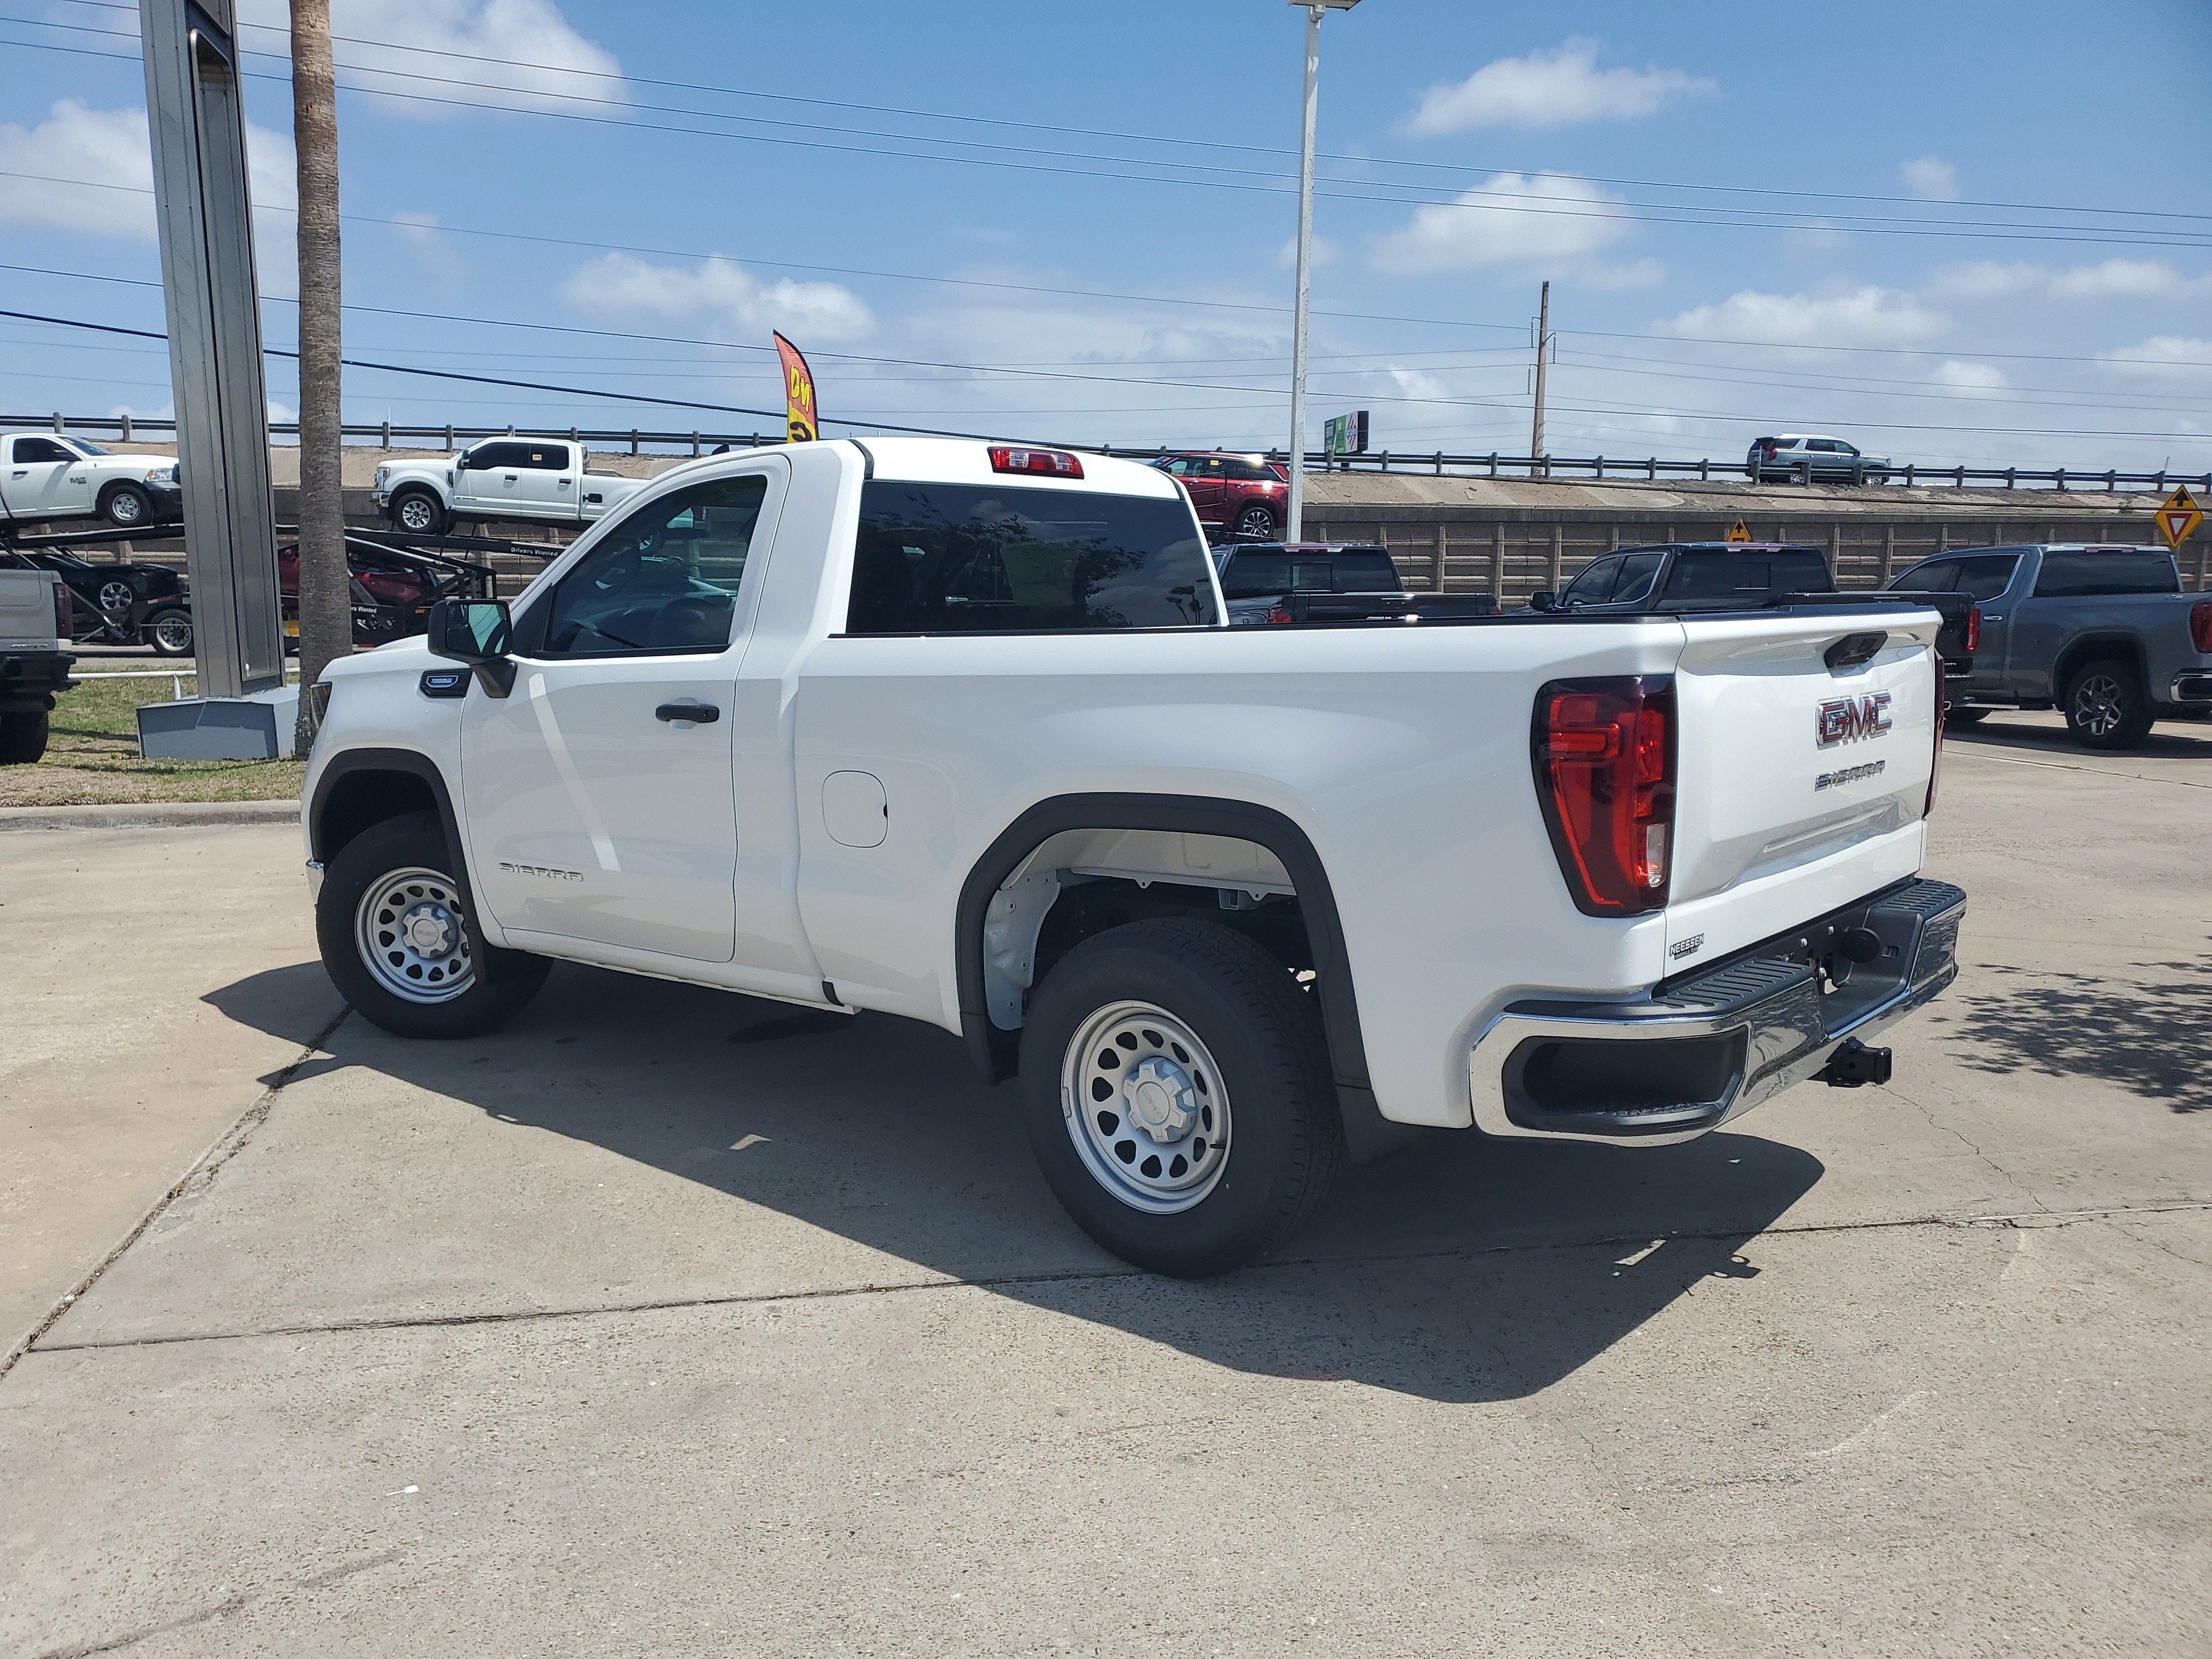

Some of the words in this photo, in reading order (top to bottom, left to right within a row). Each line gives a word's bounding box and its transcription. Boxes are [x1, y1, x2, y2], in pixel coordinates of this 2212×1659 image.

[1815, 690, 1893, 747] GMC
[1815, 760, 1886, 791] SIERRA
[499, 862, 584, 882] SIERRA
[1669, 933, 1705, 957] NEESSEN
